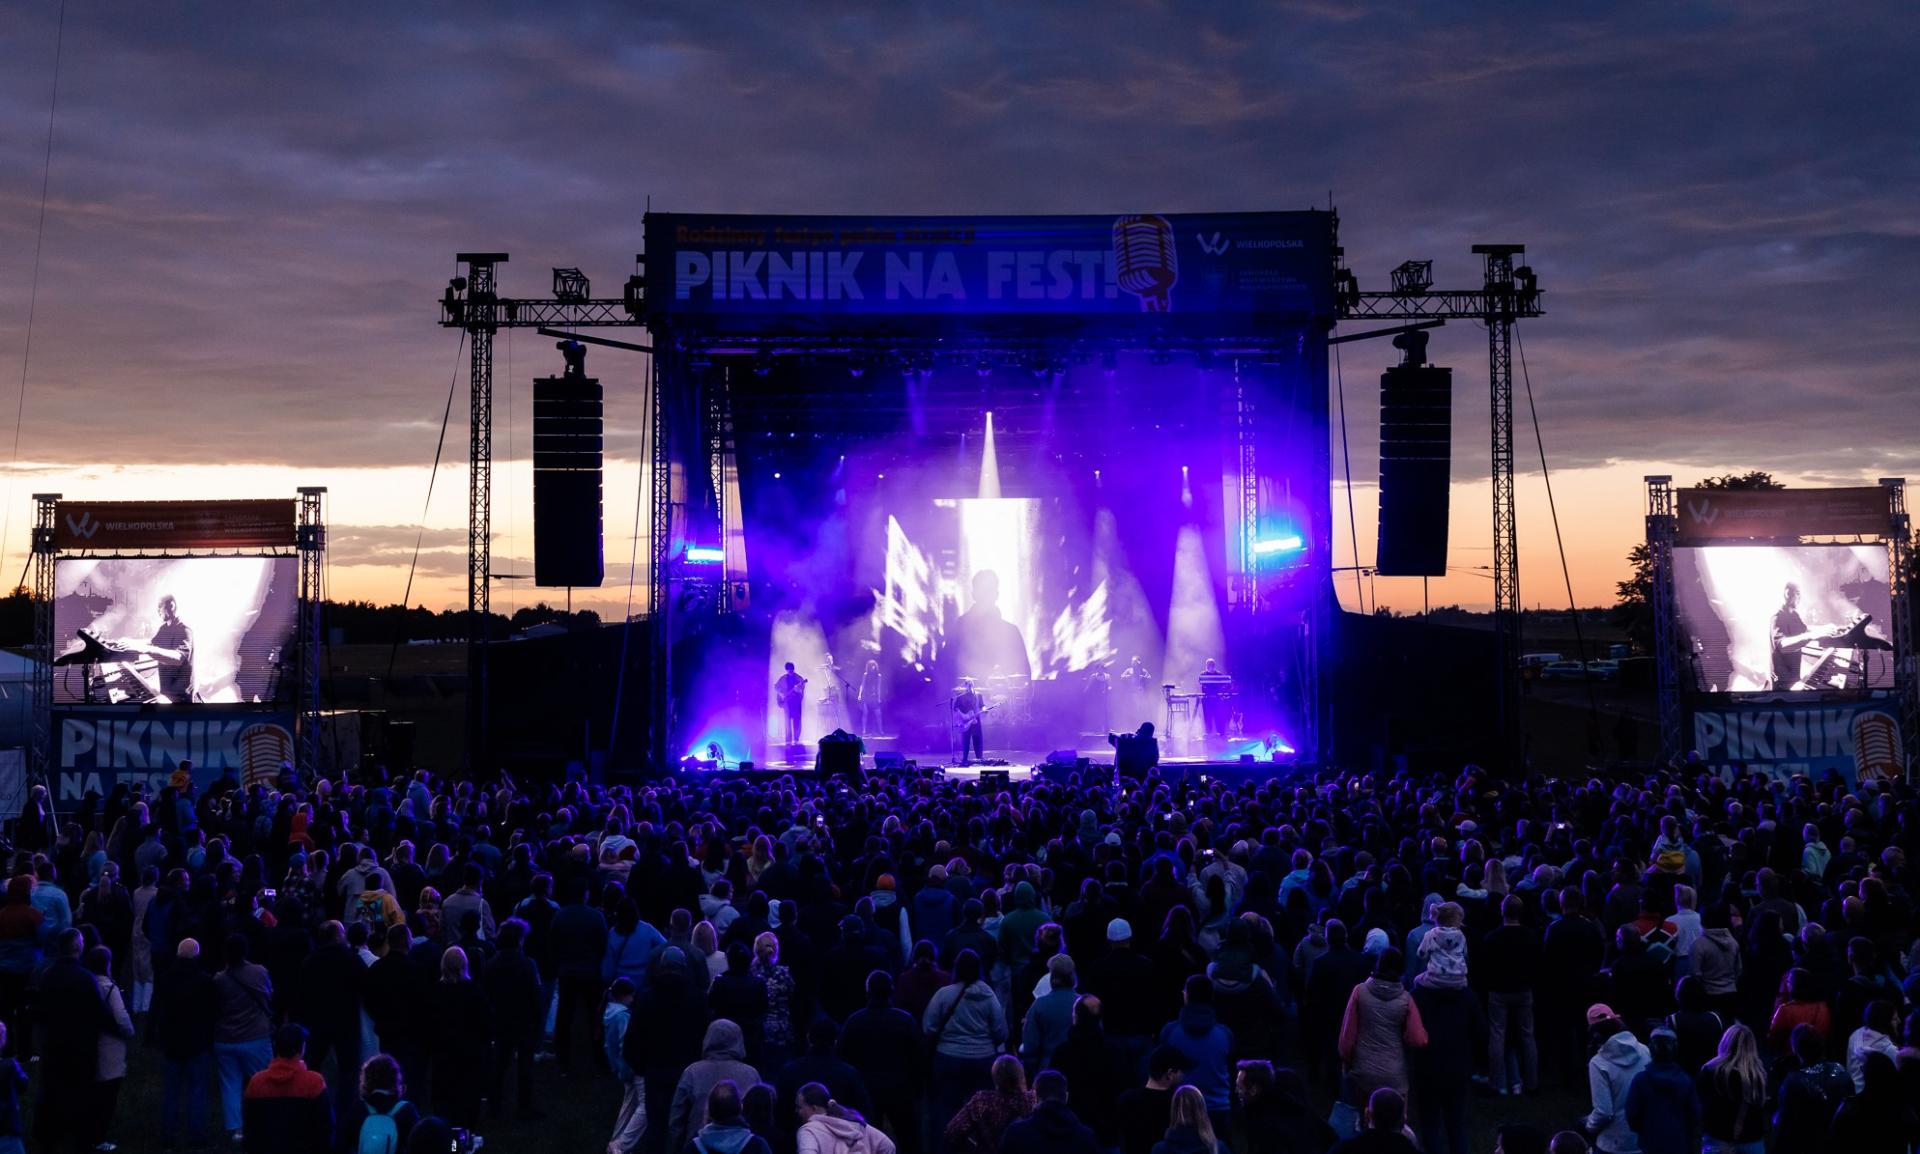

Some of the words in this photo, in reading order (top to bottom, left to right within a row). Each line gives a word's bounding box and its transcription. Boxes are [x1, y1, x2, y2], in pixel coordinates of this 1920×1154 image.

[1236, 240, 1304, 249] WIELKOPOLSKA
[675, 250, 864, 300] PIKNIK
[885, 250, 966, 299] NA
[987, 250, 1118, 299] FEST!
[105, 521, 174, 531] WIELKOPOLSKA
[61, 719, 242, 768] PIKNIK
[1694, 709, 1855, 760] PIKNIK
